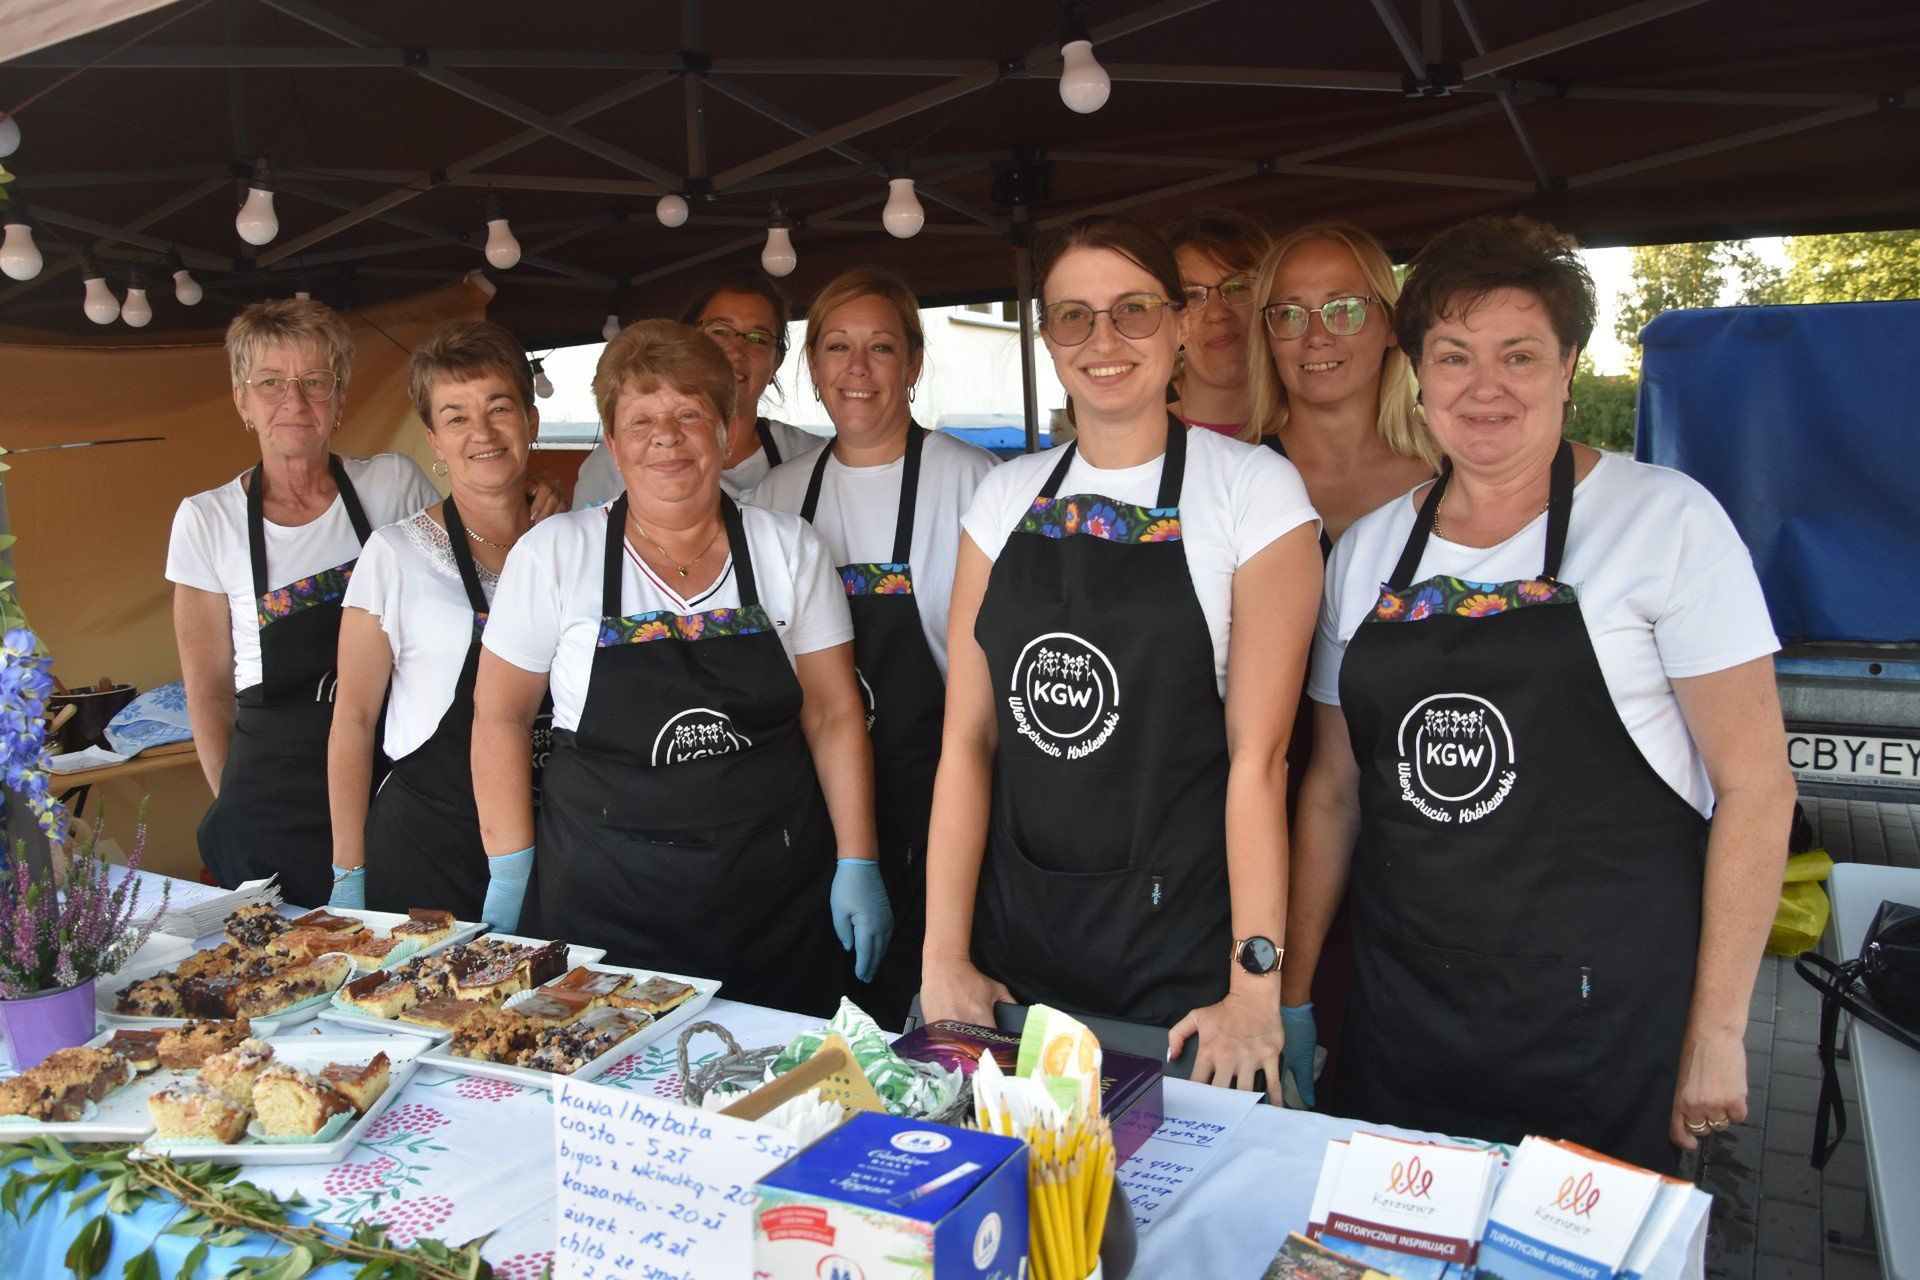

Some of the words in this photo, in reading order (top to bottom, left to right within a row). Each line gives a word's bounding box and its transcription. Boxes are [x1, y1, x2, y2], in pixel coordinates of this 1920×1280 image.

[1034, 680, 1092, 708] KGW
[1008, 697, 1061, 758] Wierzchucin
[1067, 712, 1119, 759] Królewski
[1426, 742, 1485, 768] KGW
[1787, 737, 1866, 772] CBY
[1880, 742, 1920, 776] EY
[1398, 762, 1451, 823] Wierzchucin
[1458, 770, 1516, 823] Królewski
[560, 1083, 612, 1118] kawa
[631, 1103, 712, 1140] herbata
[559, 1115, 616, 1145] ciasto
[559, 1140, 602, 1175] bigos
[562, 1171, 648, 1213] kaszanka
[668, 1204, 700, 1224] 20
[1372, 1192, 1437, 1216] Koronowo
[1534, 1204, 1592, 1236] Koronowo
[560, 1232, 605, 1260] chleb
[1334, 1220, 1397, 1245] HISTORYCZNIE
[1398, 1234, 1457, 1256] INSPIRUJĄCE
[1489, 1228, 1547, 1261] TURYSTYCZNIE
[1546, 1250, 1600, 1279] INSPIRUJĄCE
